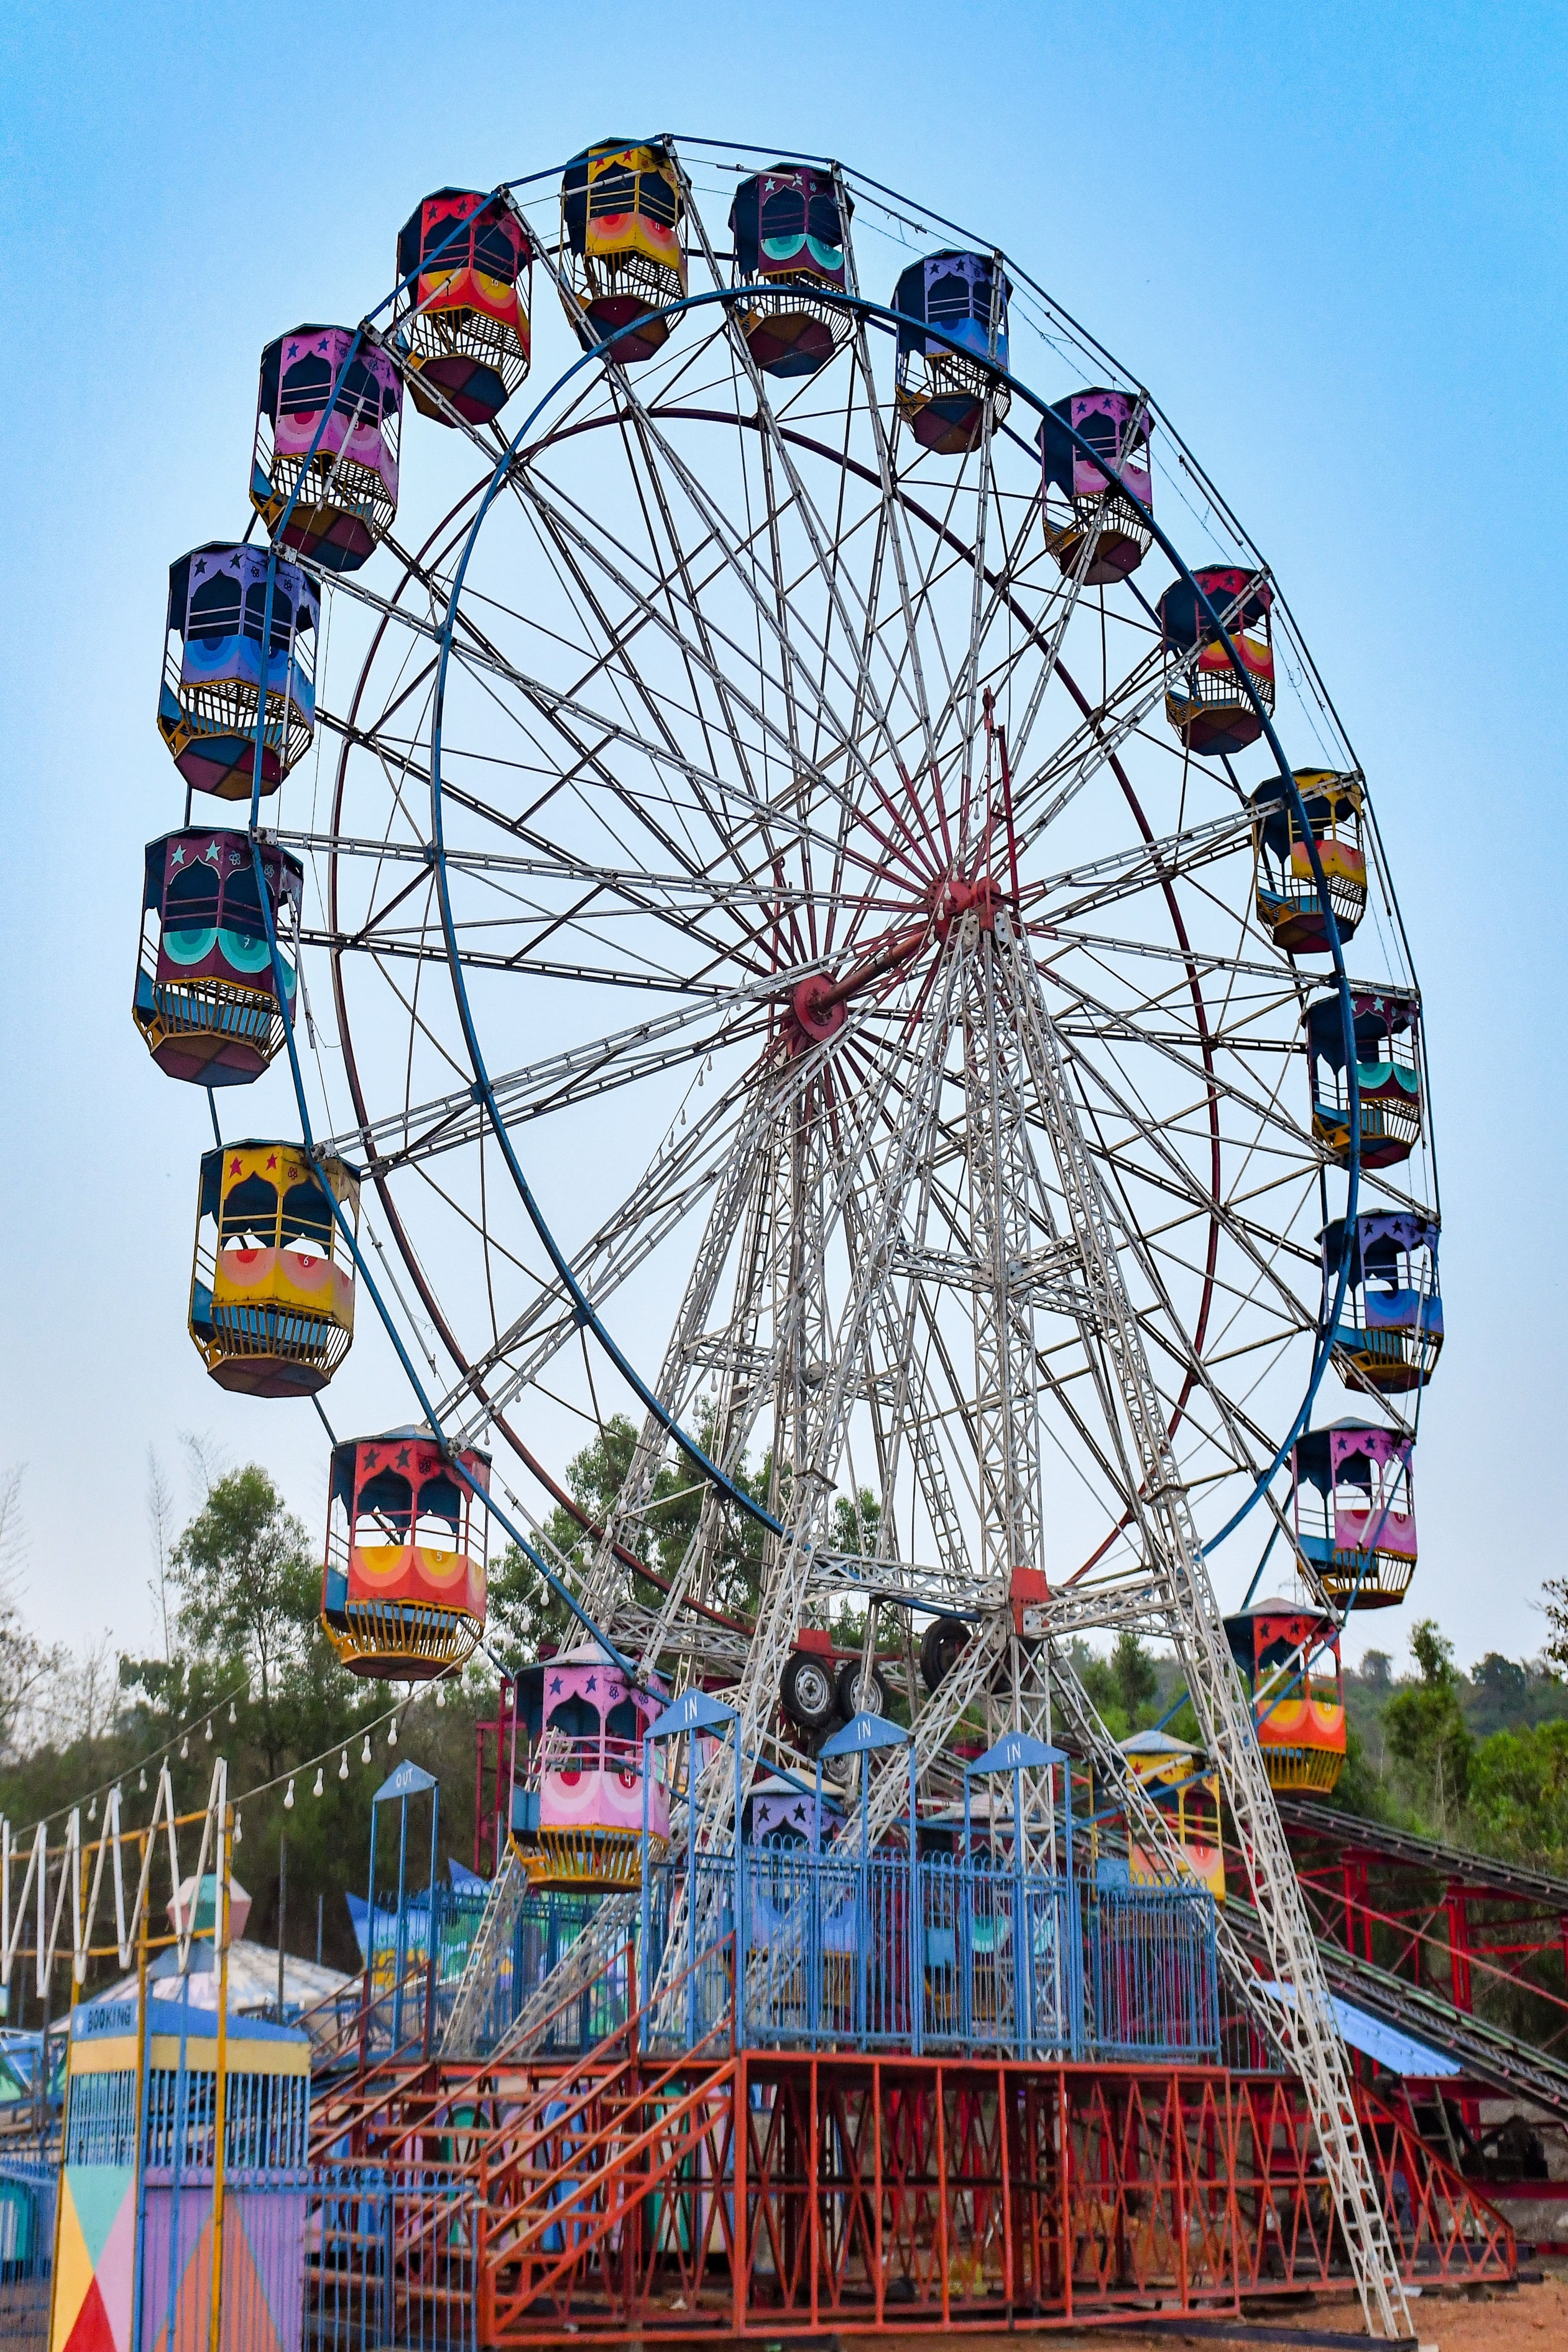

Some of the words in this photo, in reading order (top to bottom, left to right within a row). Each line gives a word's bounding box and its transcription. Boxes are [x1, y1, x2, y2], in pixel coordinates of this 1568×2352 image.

[243, 937, 251, 948] 7
[303, 1255, 310, 1266] 6
[437, 1551, 443, 1562] 5
[684, 1695, 698, 1724] IN
[857, 1718, 872, 1741] IN
[1007, 1741, 1021, 1764] IN
[396, 1767, 413, 1788] OUT
[625, 1774, 631, 1787] 4
[87, 2004, 131, 2033] BOOKING
